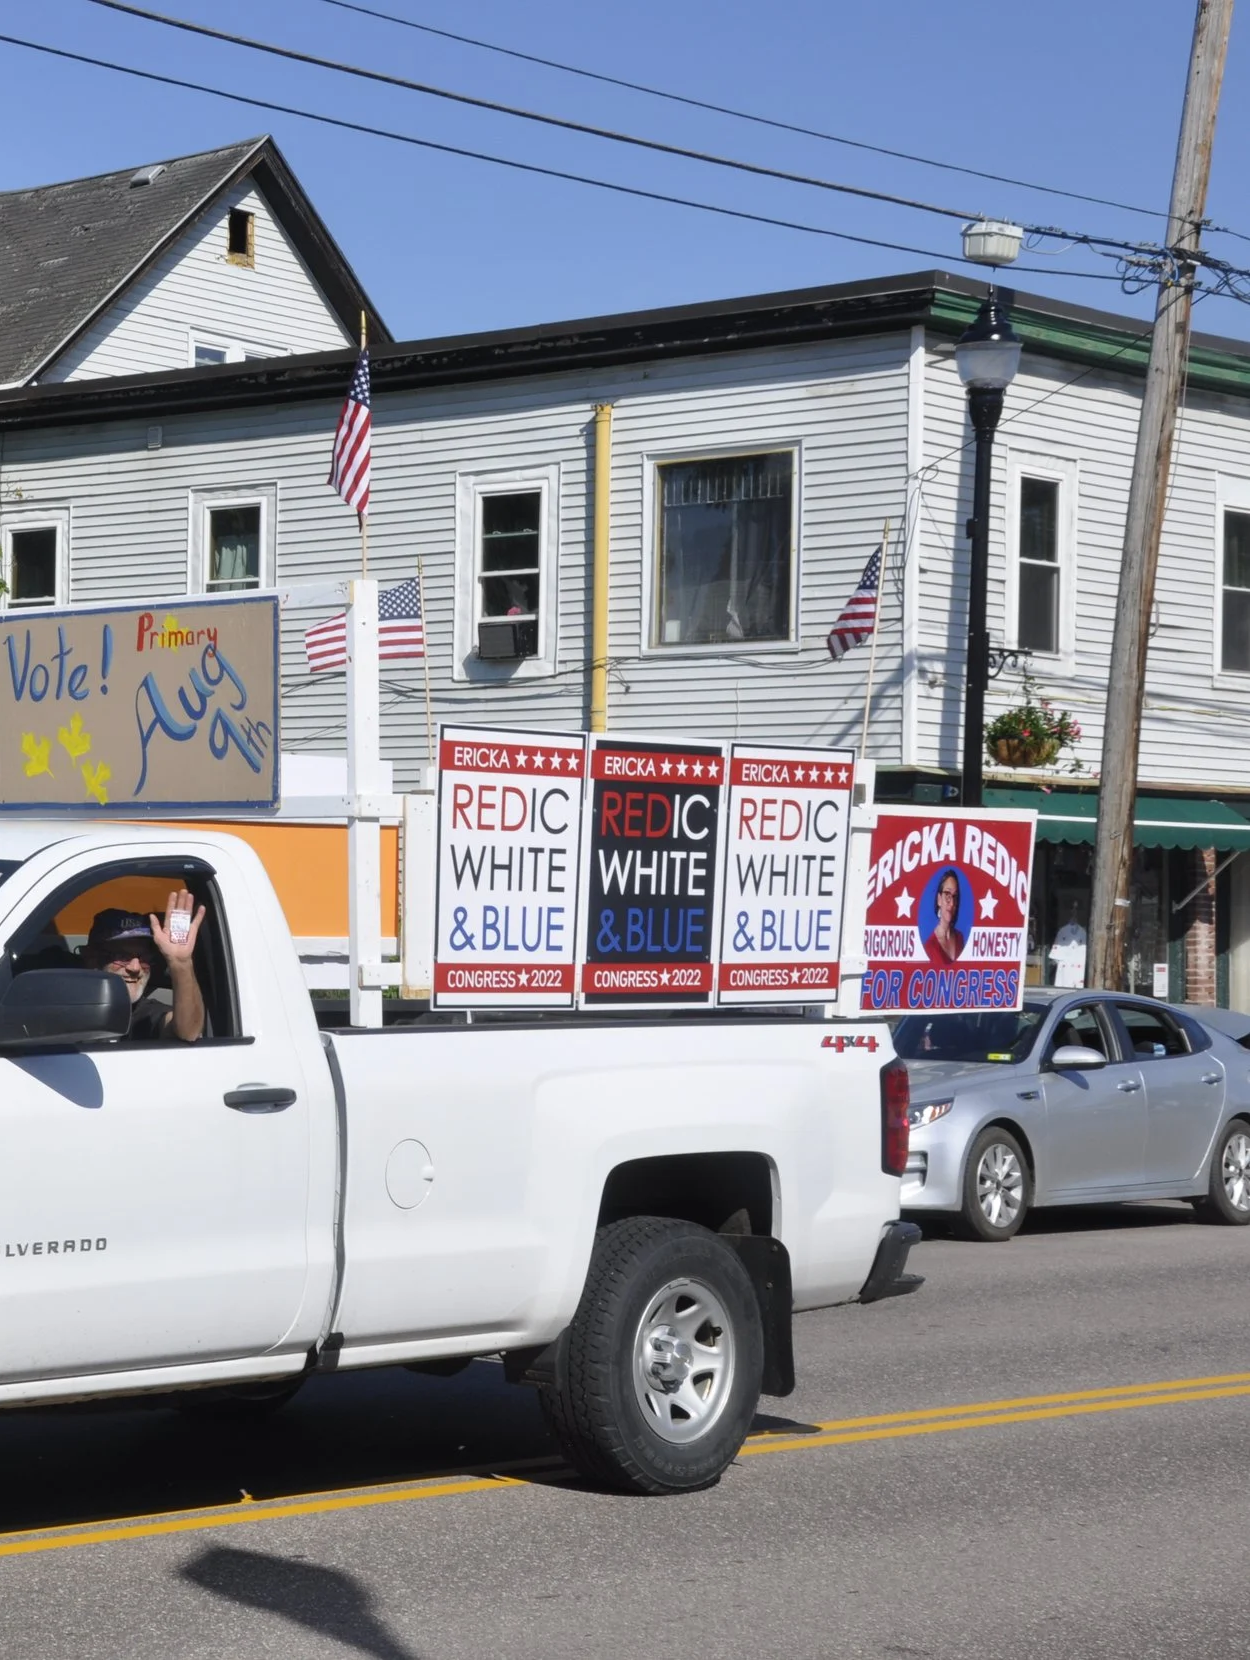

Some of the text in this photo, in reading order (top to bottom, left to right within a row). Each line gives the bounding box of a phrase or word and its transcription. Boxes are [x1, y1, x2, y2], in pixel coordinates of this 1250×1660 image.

[136, 612, 218, 658] Primary
[3, 623, 113, 702] Vote!
[133, 643, 248, 797] Aug
[453, 746, 510, 768] ERICKA
[604, 756, 656, 776] ERICKA
[741, 764, 790, 783] ERICKA
[452, 783, 570, 835] REDIC
[600, 790, 711, 840] REDIC
[738, 798, 840, 843] REDIC
[450, 844, 568, 893] WHITE
[598, 849, 708, 896] WHITE
[736, 854, 836, 897] WHITE
[866, 822, 1028, 917] ERICKA REDIC
[972, 931, 1022, 958] HONESTY
[447, 969, 563, 988] CONGRESS 2022
[594, 969, 702, 988] CONGRESS 2022
[729, 969, 829, 987] CONGRESS 2022
[860, 969, 1020, 1010] FOR CONGRESS
